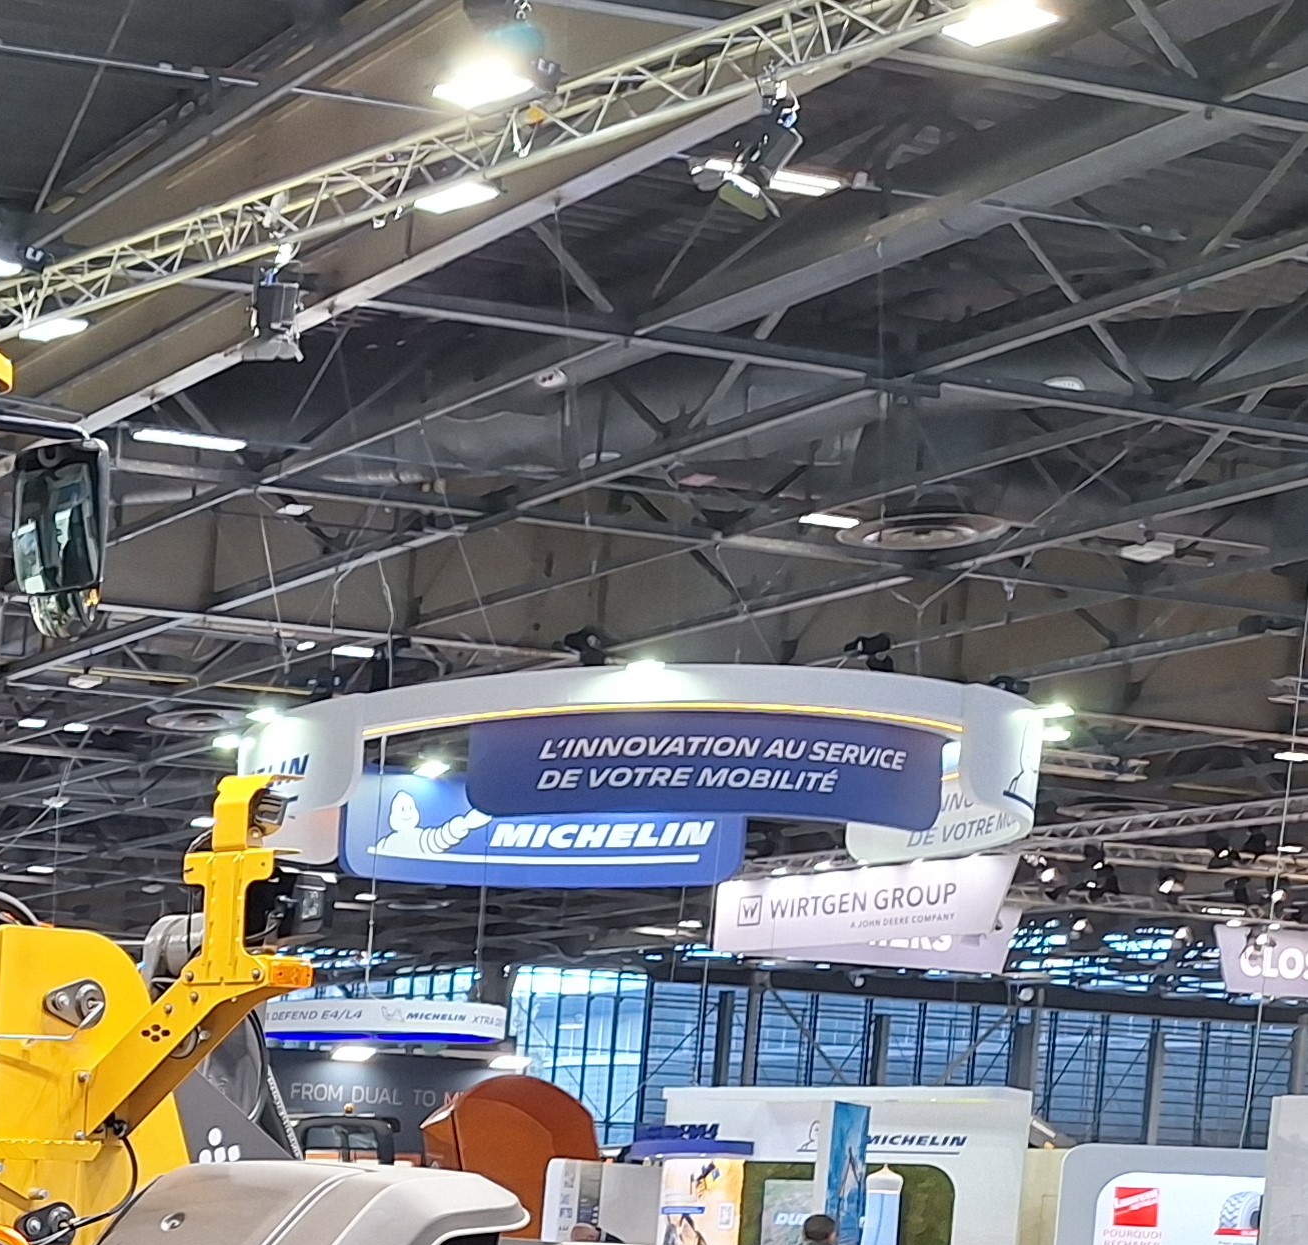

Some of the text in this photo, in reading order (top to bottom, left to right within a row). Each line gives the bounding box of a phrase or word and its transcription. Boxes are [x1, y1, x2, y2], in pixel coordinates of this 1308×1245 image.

[763, 738, 807, 761] AU
[808, 740, 907, 771] SERVICE
[536, 766, 839, 793] DE VOTRE MOBILITÉ
[490, 821, 716, 848] MICHELIN
[906, 828, 938, 848] DE
[941, 814, 995, 843] VOTRE
[770, 891, 868, 919] WIRTGEN
[873, 882, 958, 910] GROUP
[857, 918, 882, 929] JOHN
[883, 915, 910, 926] DEERE
[911, 911, 956, 924] COMPANY
[271, 1010, 318, 1020] DEFEND
[321, 1009, 363, 1020] E4/L4
[406, 1012, 467, 1021] MICHELIN
[291, 1082, 343, 1101] FROM
[351, 1085, 403, 1105] DUAL
[413, 1089, 436, 1106] TO
[867, 1135, 967, 1146] MICHELIN
[1103, 1229, 1162, 1239] POURQUOI
